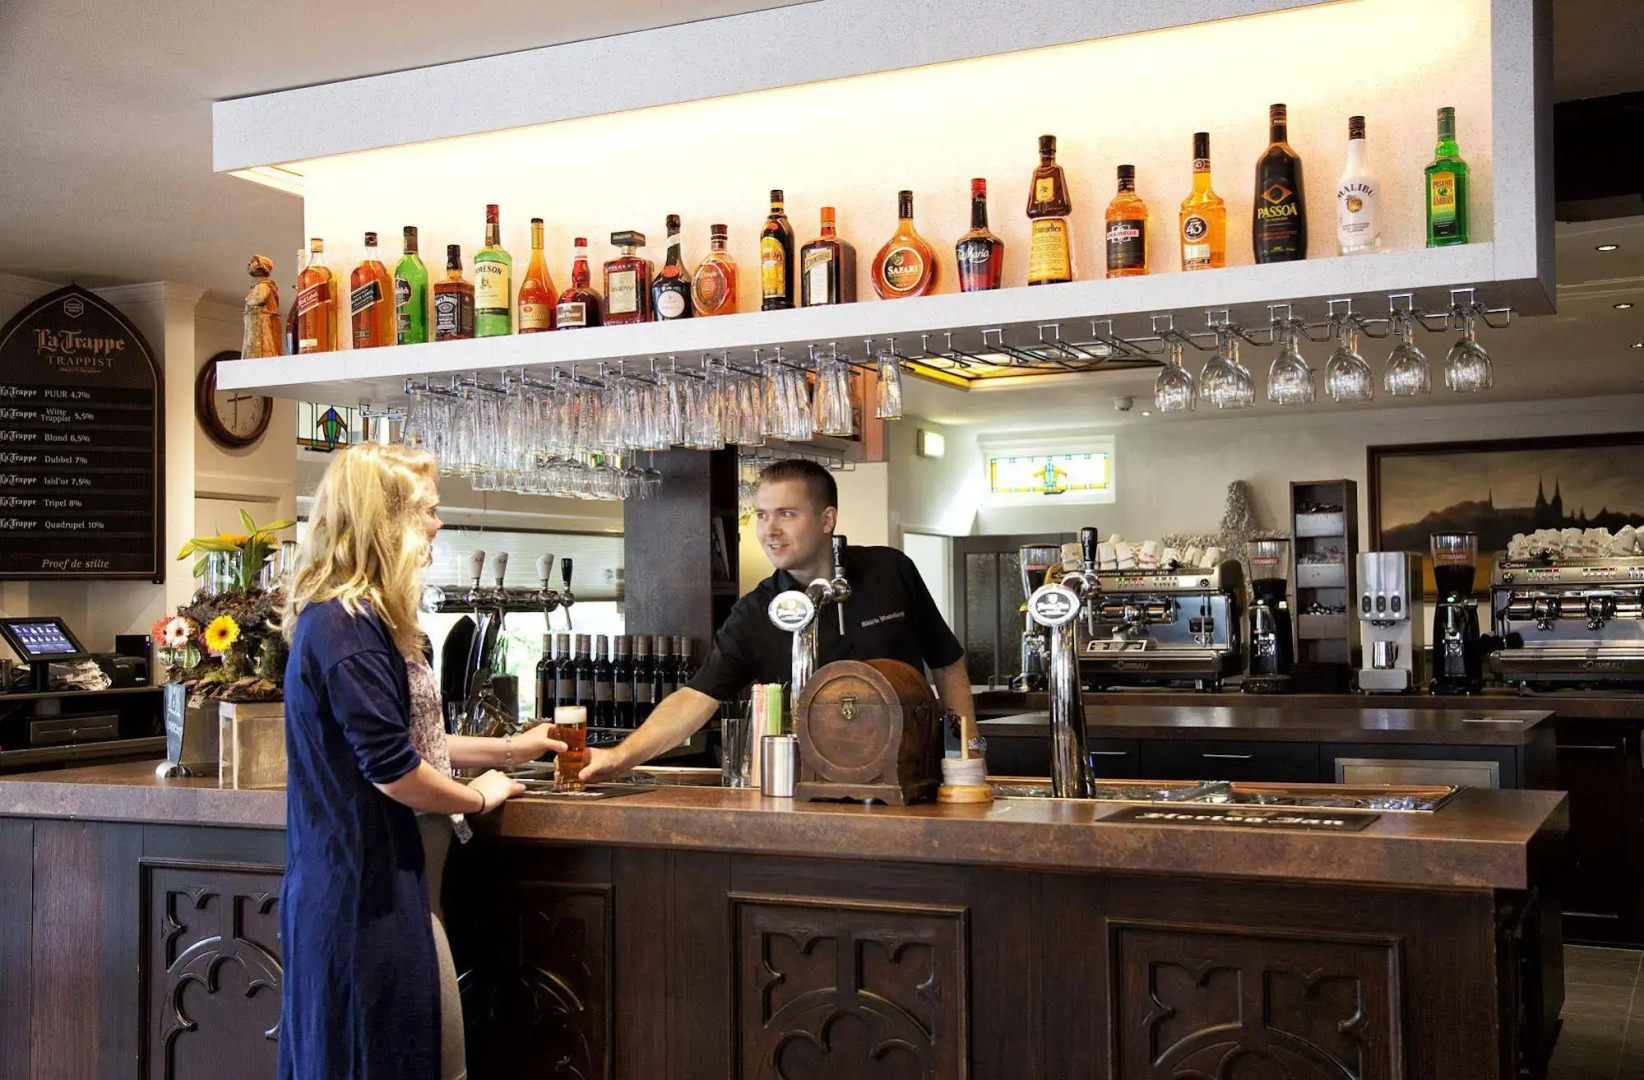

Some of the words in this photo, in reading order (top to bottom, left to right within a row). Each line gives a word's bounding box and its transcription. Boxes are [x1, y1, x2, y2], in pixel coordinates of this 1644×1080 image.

[1338, 184, 1376, 200] MALIBU
[1185, 220, 1204, 235] 43
[966, 246, 990, 262] Maria
[475, 265, 502, 275] AMESON
[887, 264, 919, 275] SAFARI
[33, 328, 58, 355] La
[58, 329, 125, 355] Trappe
[47, 355, 114, 368] TRAPPIST
[9, 387, 37, 398] Trappe
[44, 389, 68, 398] PUUR
[9, 409, 37, 420] Trappe
[46, 408, 67, 416] Witte
[41, 414, 71, 424] Trappist
[9, 431, 37, 442] Trappe
[44, 433, 68, 442] Blond
[9, 453, 37, 464] Trappe
[44, 455, 72, 464] Dubbel
[75, 456, 88, 464] 7%
[9, 475, 37, 486] Trappe
[44, 477, 69, 486] Isid'or
[9, 497, 37, 508] Trappe
[44, 499, 67, 509] Tripel
[69, 499, 82, 508] 8%
[9, 519, 37, 530] Trappe
[44, 520, 85, 530] Quadrupel
[88, 521, 105, 530] 10%
[42, 558, 69, 570] Proef
[70, 558, 82, 569] de
